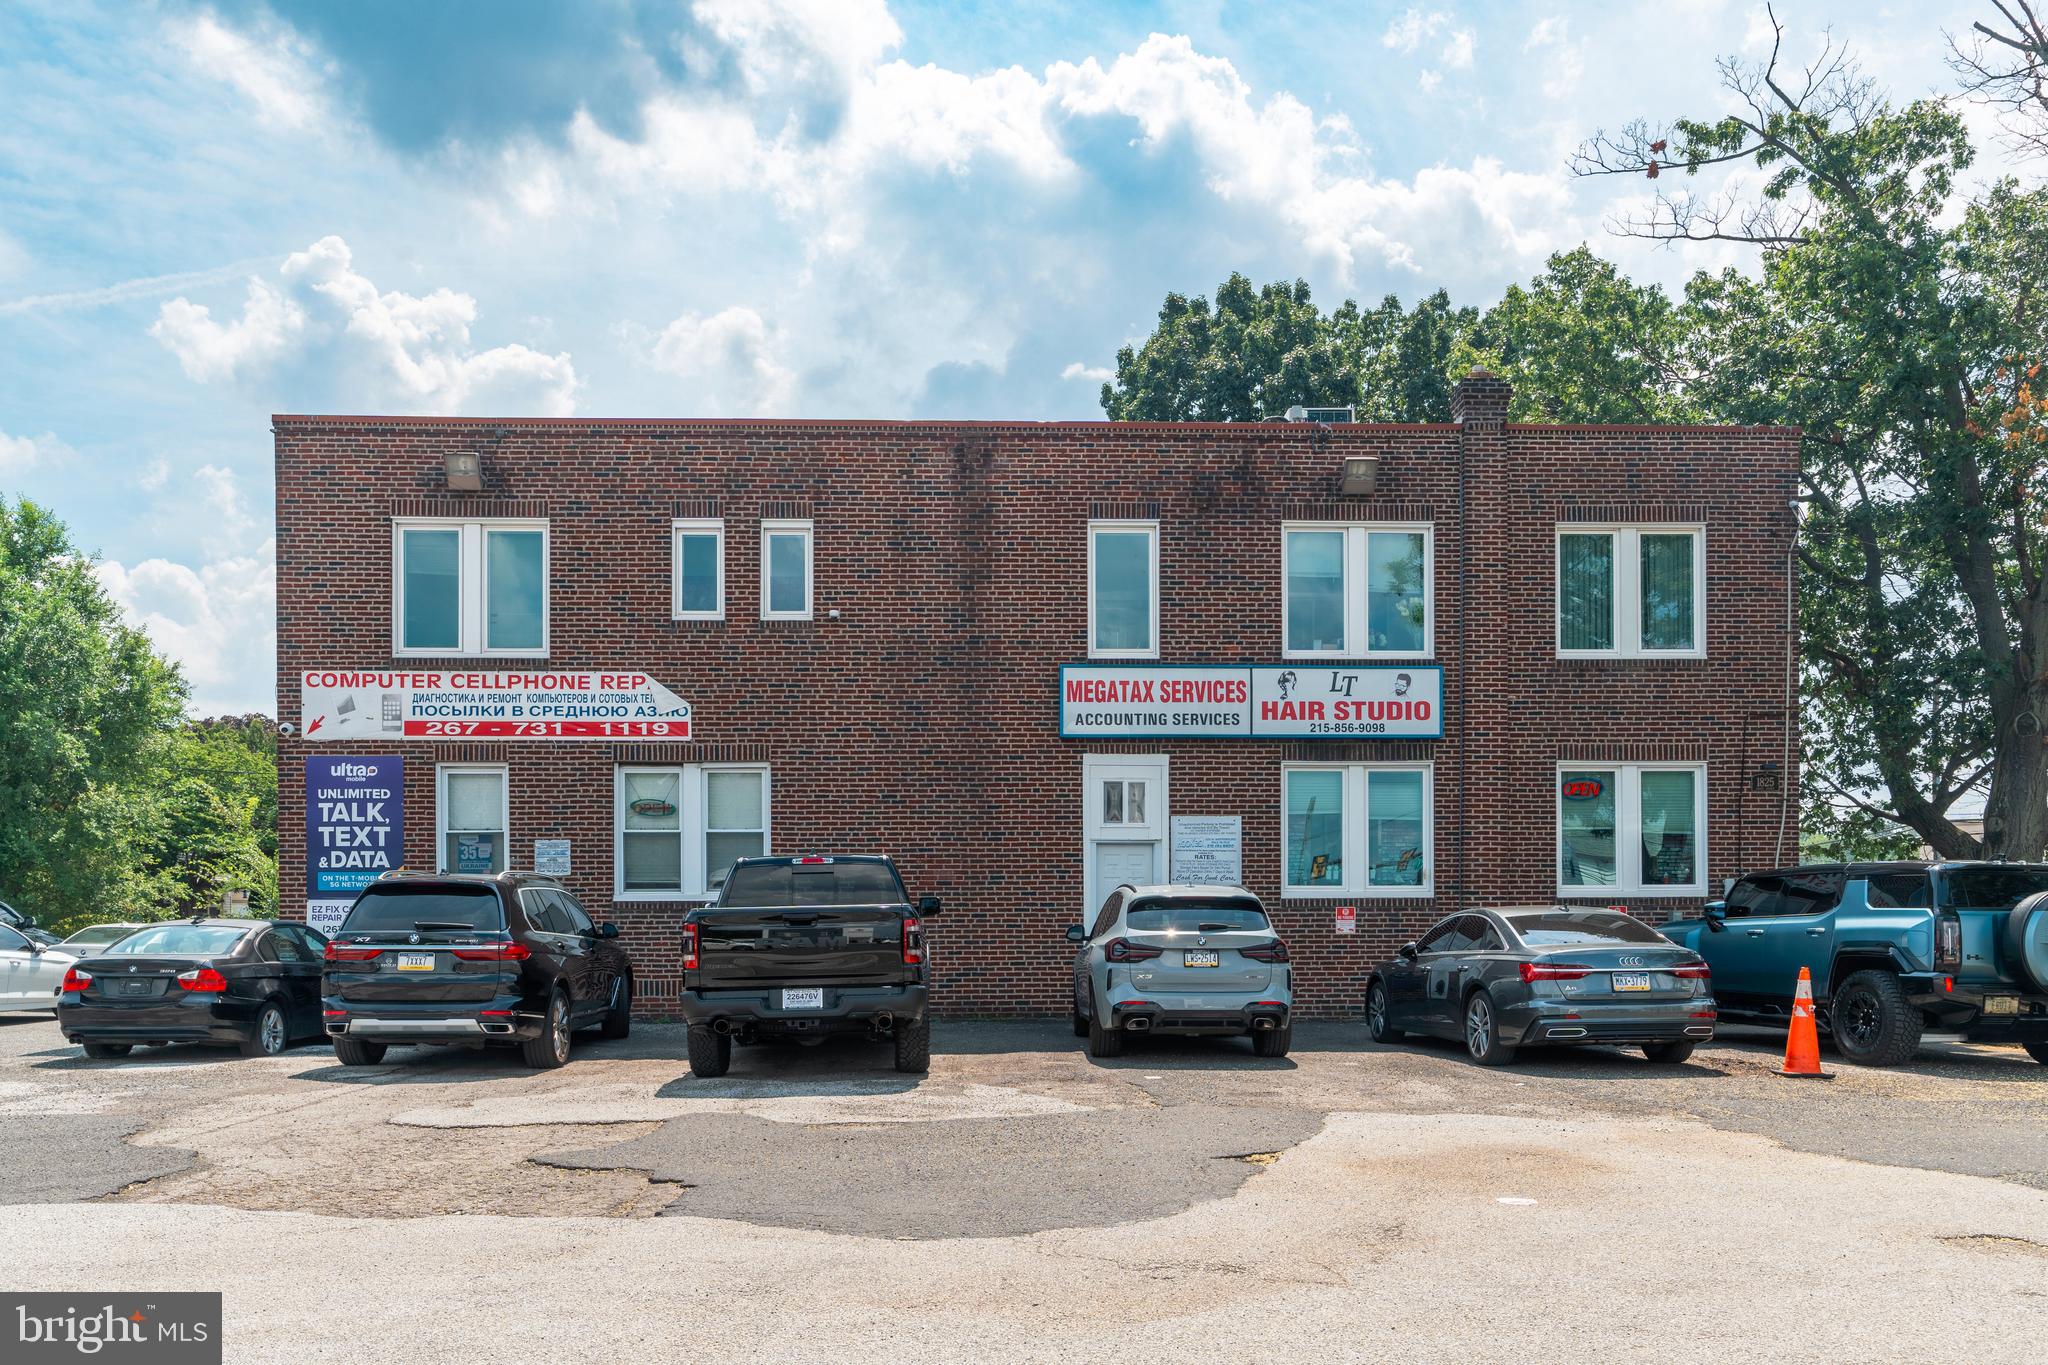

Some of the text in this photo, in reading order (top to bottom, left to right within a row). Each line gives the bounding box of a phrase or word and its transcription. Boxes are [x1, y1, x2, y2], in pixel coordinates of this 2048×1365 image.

[305, 672, 650, 690] COMPUTER CELLPHONE REP
[1329, 671, 1358, 697] LT
[412, 693, 655, 704] ДИАГНОСТИКА И РЕМОНТ КОМПЬЮТЕРОВ И СОТОВЫХ ТЕЛ
[1066, 680, 1247, 704] MEGATAX SERVICES
[412, 705, 505, 716] ПОСЫЛКИ
[512, 705, 524, 716] В
[529, 705, 628, 718] СРЕДНЮЮ
[1261, 700, 1431, 721] HAIR STUDIO
[1075, 713, 1240, 726] ACCOUNTING SERVICES
[425, 722, 480, 735] 267
[511, 722, 562, 735] 731
[600, 722, 670, 735] 1119
[1310, 723, 1385, 733] 215-856-9098
[330, 762, 367, 777] ultra
[1562, 781, 1601, 797] OPEN
[1756, 777, 1775, 787] 1825
[317, 788, 391, 799] UNLIMITED
[317, 802, 390, 824] TALK,
[317, 826, 391, 847] TEXT
[460, 845, 477, 860] 35
[312, 905, 323, 914] EZ
[325, 905, 340, 914] FIX
